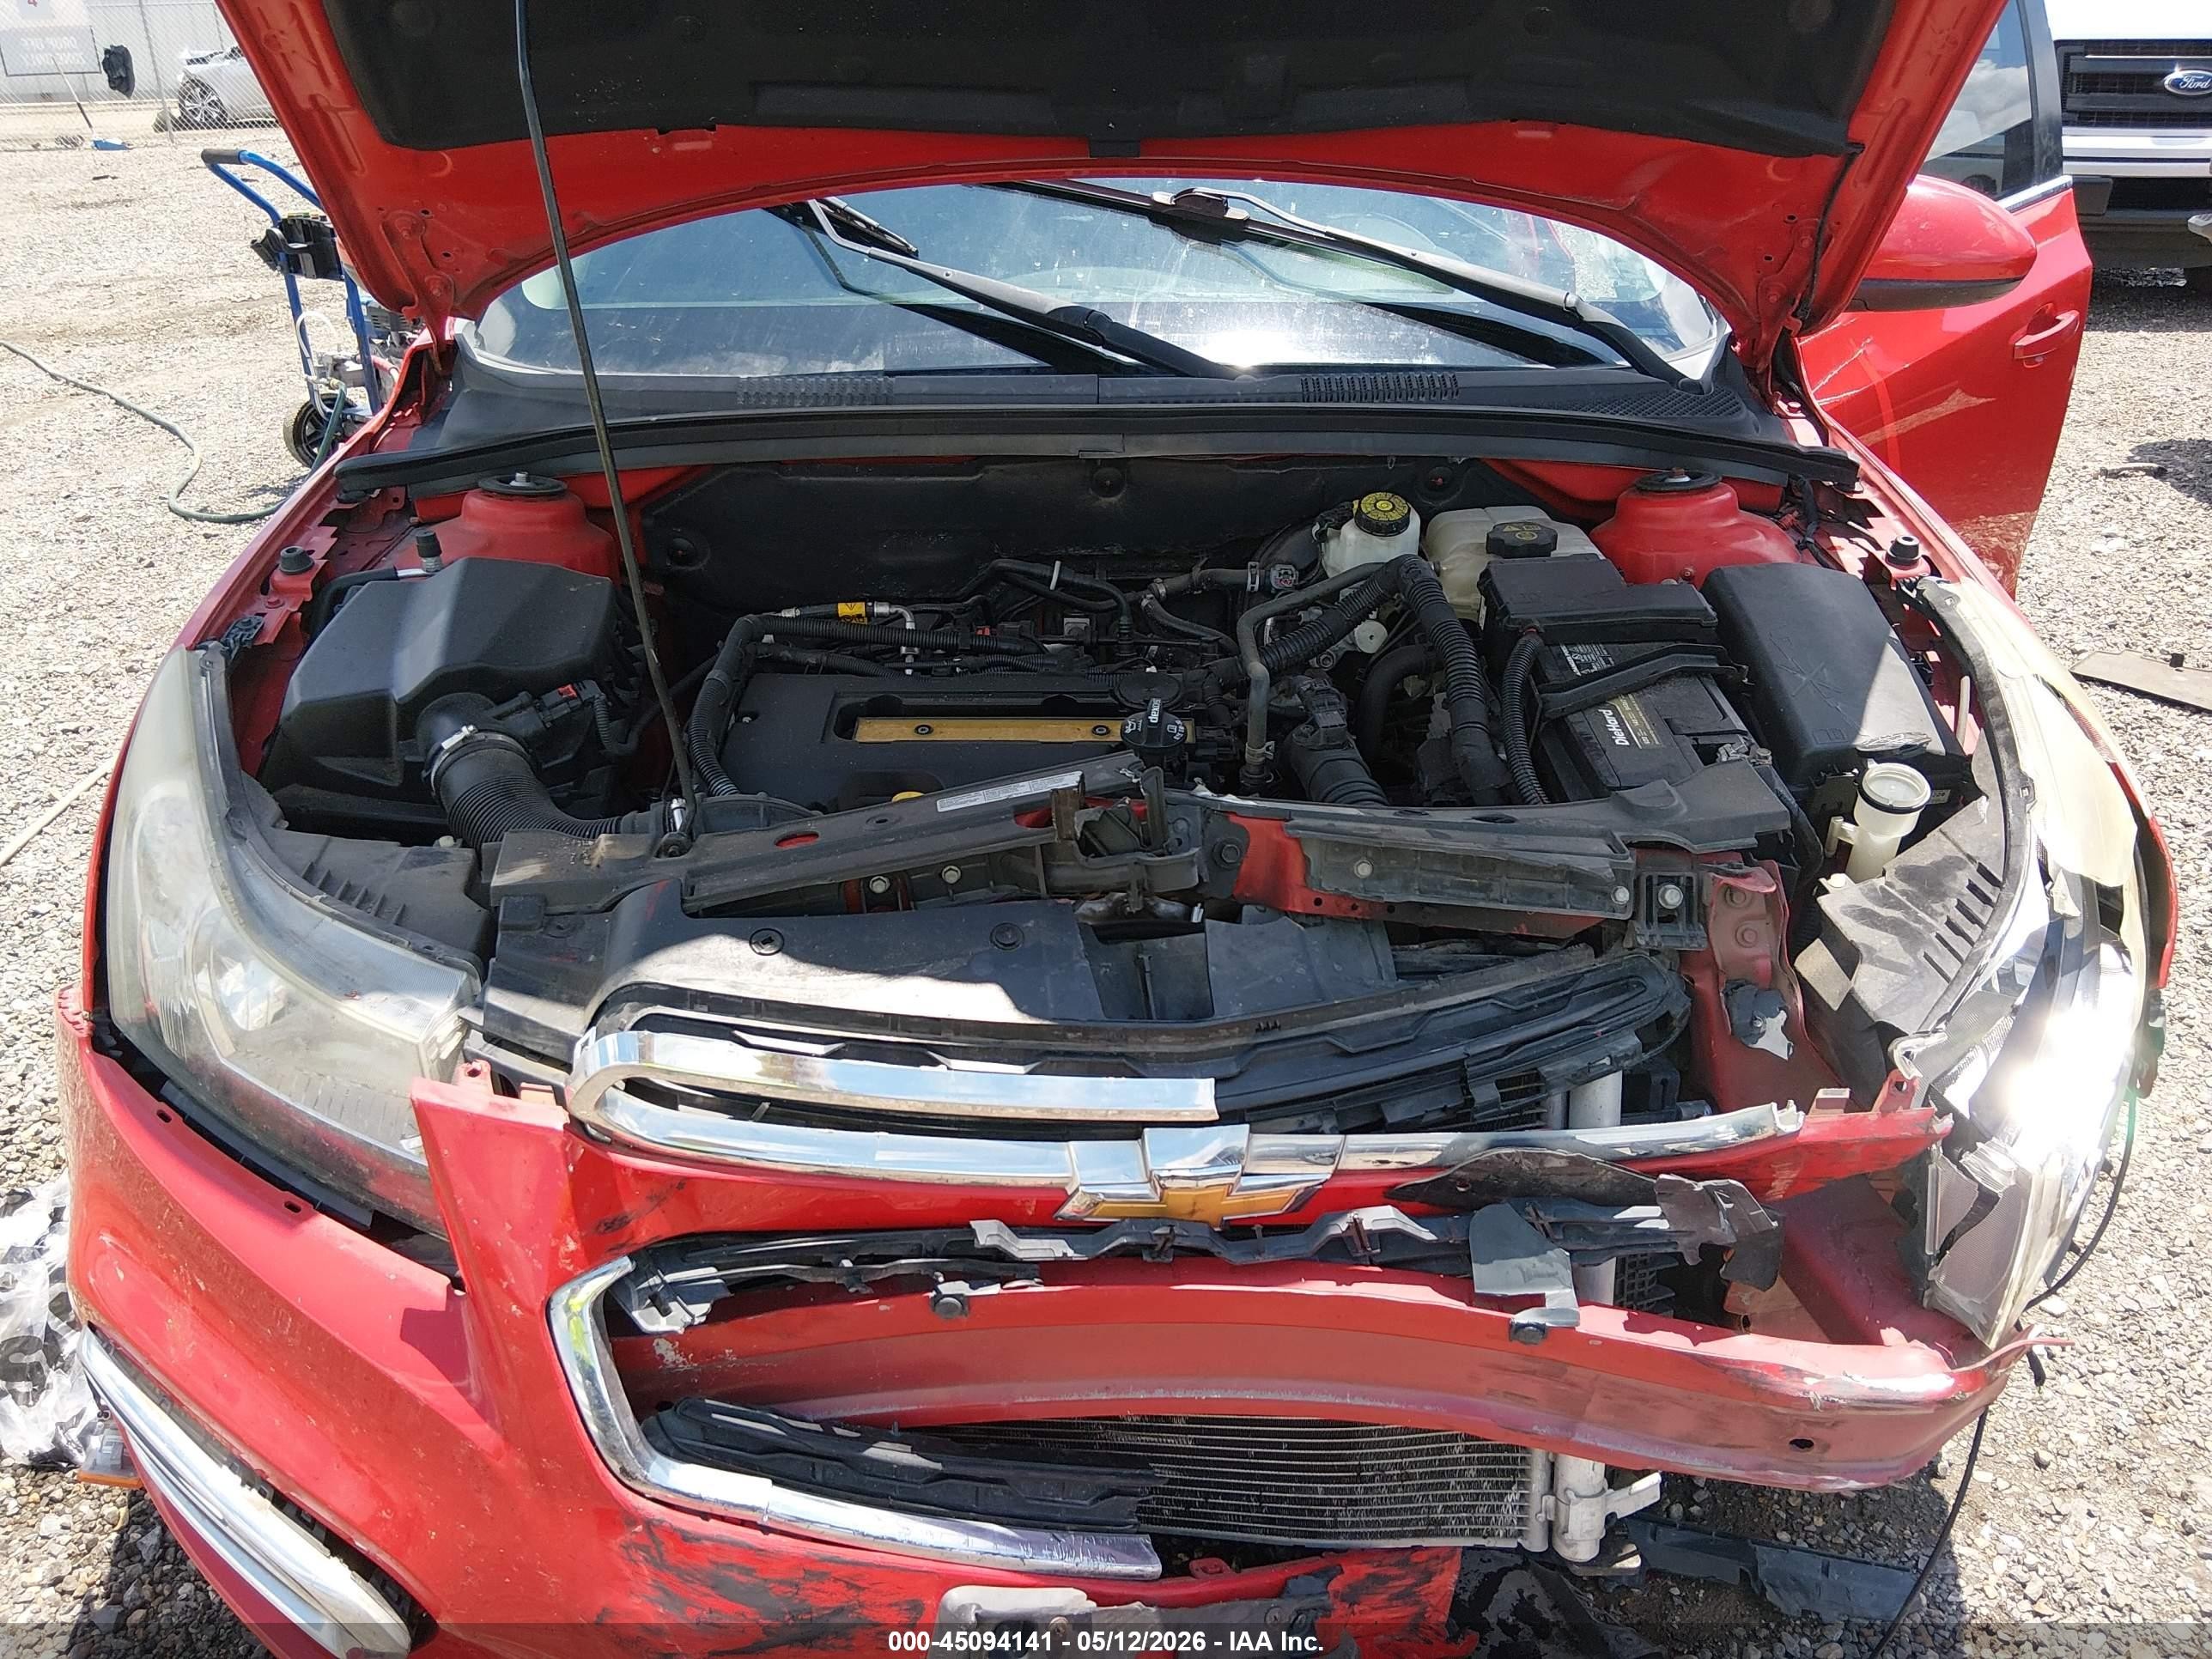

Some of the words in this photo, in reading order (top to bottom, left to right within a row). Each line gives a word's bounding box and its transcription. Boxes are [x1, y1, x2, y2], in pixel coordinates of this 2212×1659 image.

[2179, 76, 2211, 89] Ford
[1149, 698, 1161, 723] dexos
[1598, 708, 1630, 746] DieHard
